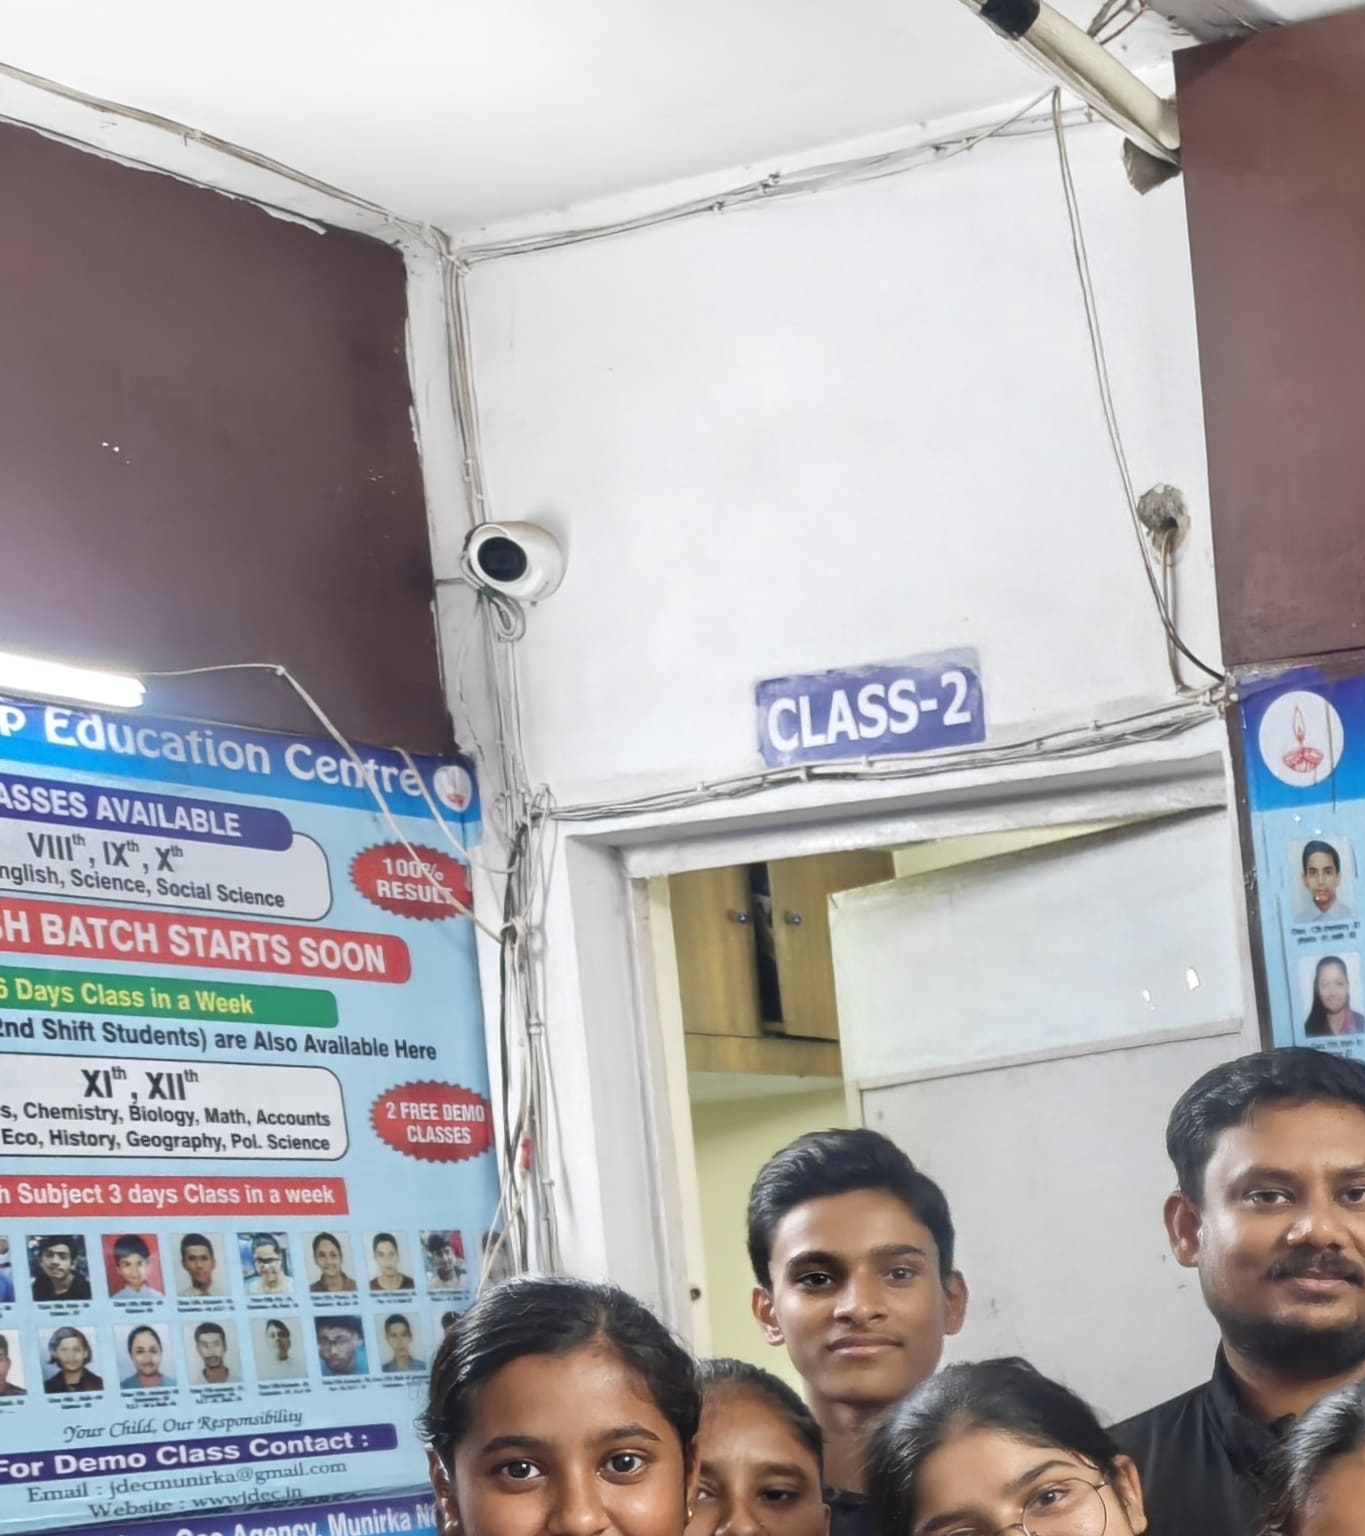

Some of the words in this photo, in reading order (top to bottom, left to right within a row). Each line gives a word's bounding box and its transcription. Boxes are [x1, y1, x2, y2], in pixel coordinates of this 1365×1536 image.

[767, 671, 972, 752] CLASS-2
[44, 705, 271, 775] Education
[285, 743, 424, 797] Centre
[0, 782, 88, 819] ASSES
[96, 795, 242, 838] AVAILABLE
[0, 864, 65, 889] nglish,
[71, 868, 151, 897] Science,
[156, 877, 212, 901] Social
[217, 884, 285, 908] Science
[382, 857, 444, 881] 100%
[376, 879, 453, 904] RESULT
[40, 913, 160, 954] BATCH
[168, 924, 292, 966] STARTS
[300, 937, 387, 974] SOON
[15, 978, 74, 1007] Days
[81, 982, 145, 1007] Class
[151, 987, 172, 1009] in
[178, 994, 191, 1010] a
[195, 990, 254, 1014] Week
[42, 1018, 96, 1041] Shift
[102, 1021, 207, 1053] Students)
[215, 1033, 247, 1049] are
[254, 1031, 298, 1052] Also
[304, 1033, 389, 1057] Available
[394, 1039, 437, 1060] Here
[23, 1102, 124, 1125] Chemistry,
[129, 1105, 200, 1127] Biology,
[204, 1108, 251, 1126] Math,
[256, 1109, 331, 1127] Accounts
[386, 1102, 397, 1119] 2
[401, 1103, 438, 1121] FREE
[444, 1104, 485, 1122] DEMO
[1, 1128, 44, 1149] Eco,
[49, 1129, 121, 1151] History,
[126, 1131, 226, 1153] Geography,
[267, 1134, 330, 1151] Science
[407, 1126, 472, 1144] CLASSES
[17, 1182, 104, 1209] Subject
[108, 1184, 122, 1204] 3
[128, 1184, 178, 1208] days
[184, 1183, 240, 1204] Class
[245, 1184, 264, 1203] in
[269, 1189, 280, 1204] a
[285, 1185, 335, 1204] week
[64, 1426, 105, 1443] Your
[163, 1418, 194, 1432] Our
[198, 1409, 303, 1432] Responsibility
[54, 1452, 147, 1475] Demo
[156, 1444, 240, 1467] Class
[249, 1432, 353, 1457] Contact
[27, 1482, 89, 1502] Email
[109, 1461, 347, 1499] jdecmunirka@gmail.com
[88, 1501, 173, 1519] Website
